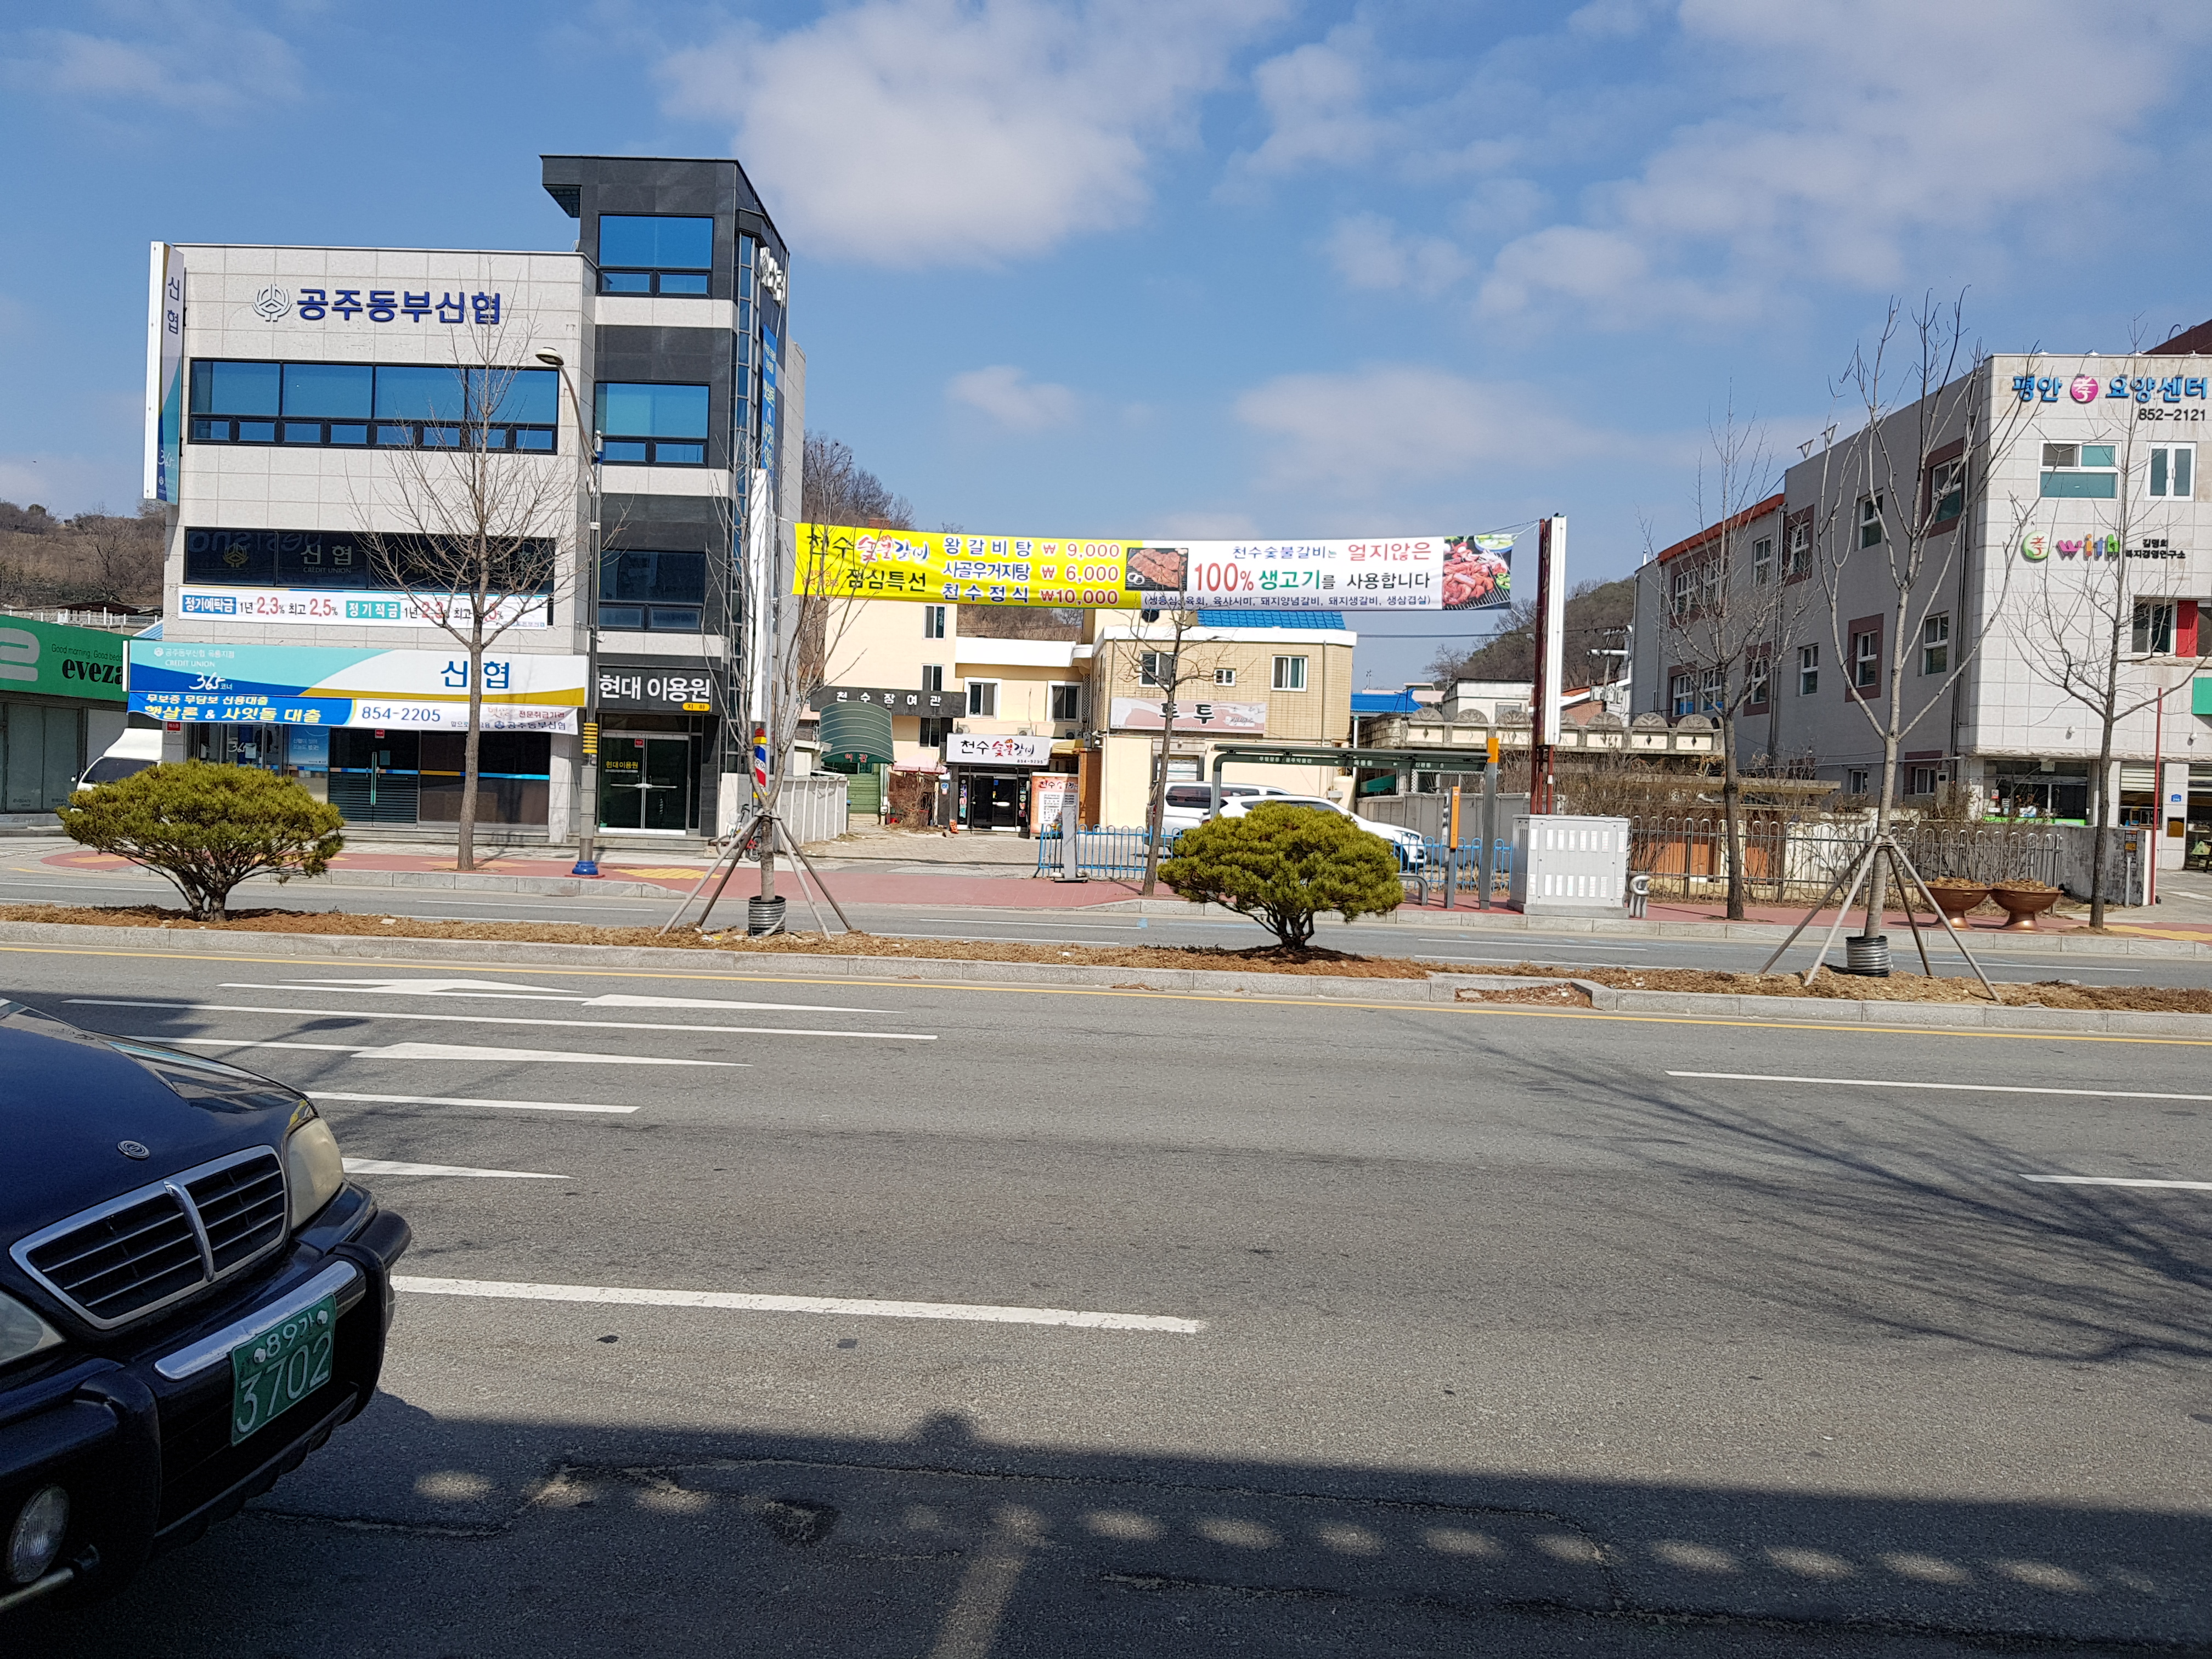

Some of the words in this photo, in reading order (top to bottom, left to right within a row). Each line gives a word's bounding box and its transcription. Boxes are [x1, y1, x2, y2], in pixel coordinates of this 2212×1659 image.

[167, 276, 179, 335] 신협
[297, 289, 500, 325] 공주동부신협
[2012, 376, 2062, 402] 평안
[2106, 377, 2208, 402] 요양센터
[2139, 408, 2205, 421] 852-2121
[301, 545, 352, 566] 신협
[944, 537, 1032, 557] 왕갈비탕
[1068, 544, 1120, 558] 9,000
[1348, 543, 1431, 562] 얼지않은
[2058, 534, 2119, 556] with
[847, 567, 926, 592] 점심특선
[943, 562, 1030, 582] 사골우거지탕
[1066, 567, 1119, 583] 6,000
[1194, 563, 1254, 592] 100%
[1259, 569, 1335, 590] 생고기를
[1347, 572, 1430, 590] 사용합니다
[942, 584, 1028, 603] 천수정식
[184, 596, 234, 613] 정기예탁금
[240, 602, 253, 614] 1년
[289, 603, 307, 616] 최고
[348, 602, 399, 618] 정기적금
[404, 607, 417, 619] 1년
[166, 648, 205, 657] 공주동부신협
[189, 672, 225, 690] 365
[441, 661, 510, 689] 신협
[600, 675, 641, 700] 현대
[647, 677, 710, 702] 이용원
[837, 691, 941, 707] 천수장여관
[146, 694, 180, 703] 무보증
[184, 695, 218, 704] 무담보
[223, 696, 268, 706] 신용대출
[222, 707, 276, 721] 사잇돌
[284, 709, 321, 723] 대출
[362, 706, 440, 722] 854-2205
[507, 721, 566, 730] 공주동부신협
[606, 761, 638, 769] 현대이용원
[266, 1312, 314, 1358] 89가
[236, 1331, 331, 1433] 3702
